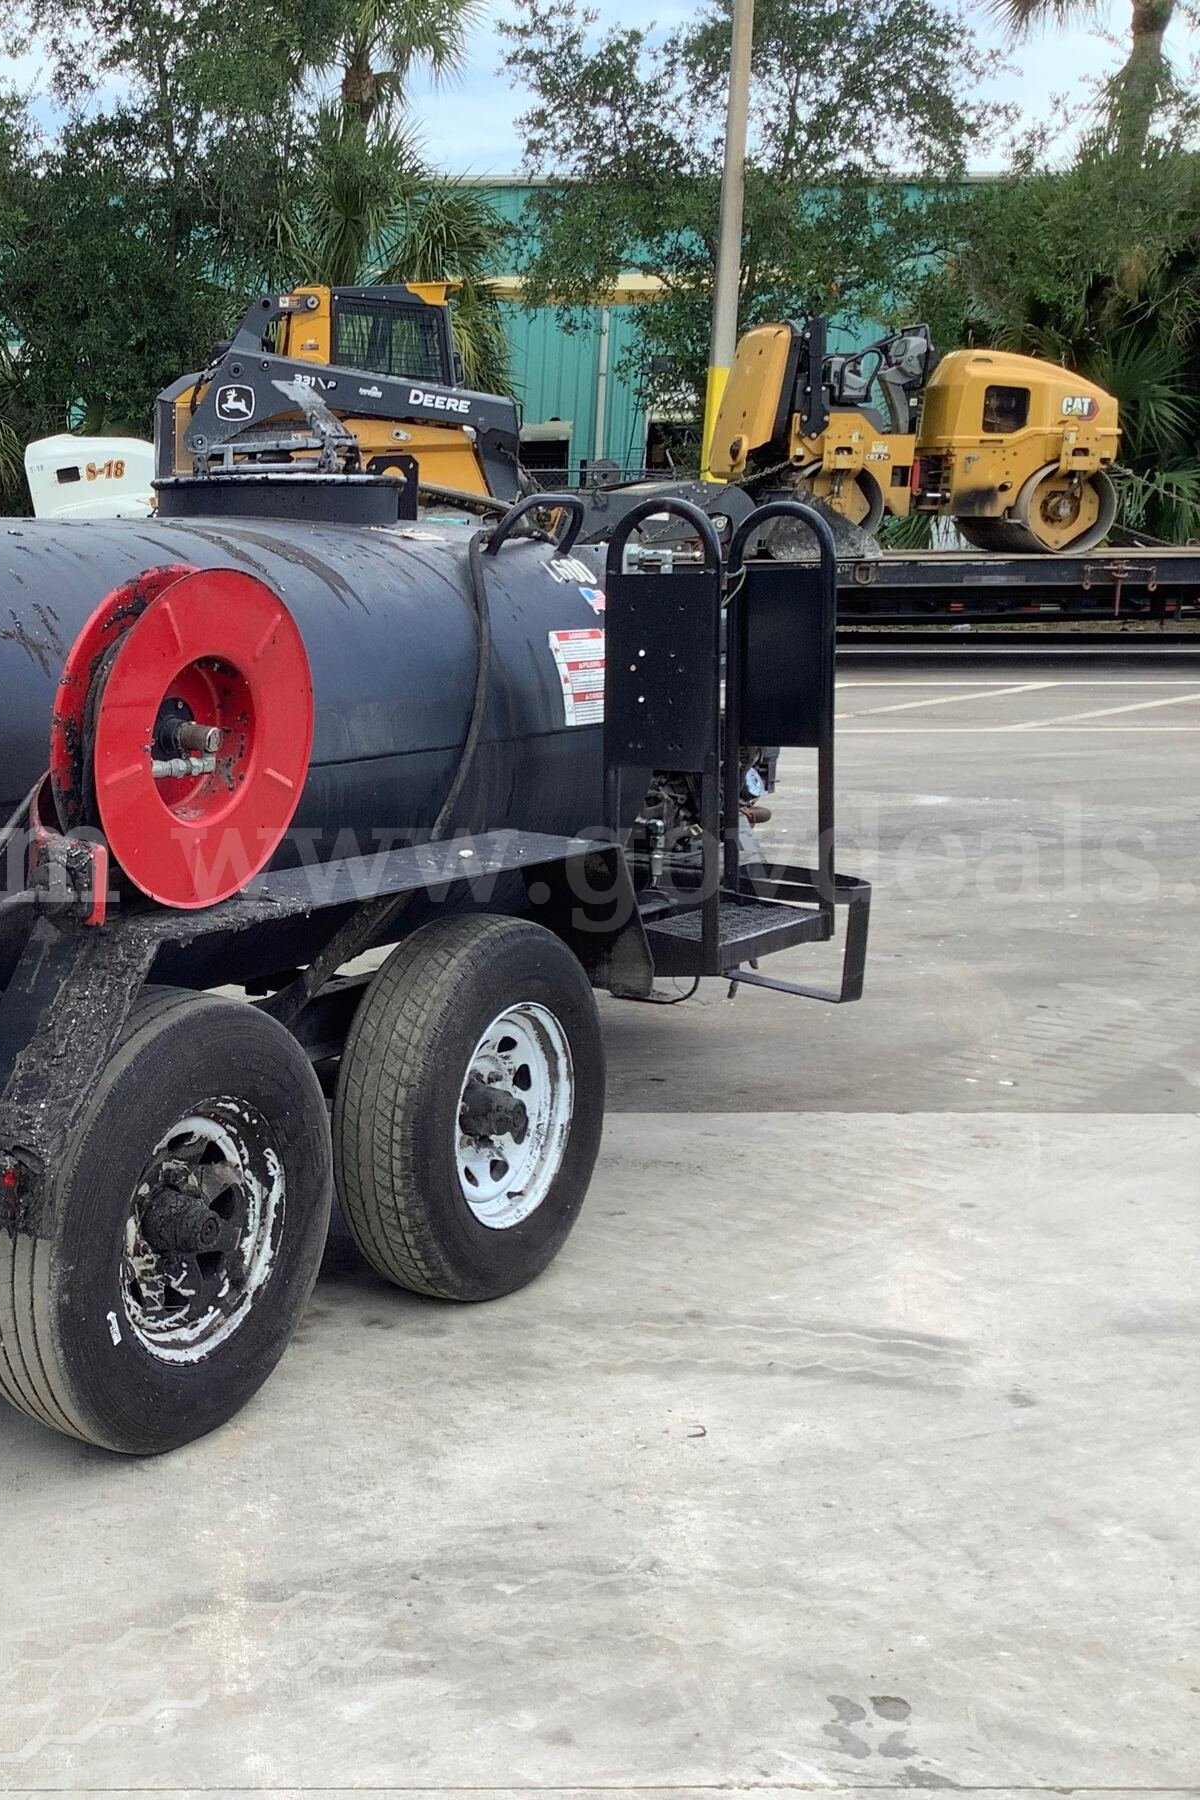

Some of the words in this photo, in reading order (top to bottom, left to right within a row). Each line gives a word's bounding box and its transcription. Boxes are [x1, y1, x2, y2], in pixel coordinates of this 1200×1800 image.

[408, 389, 471, 413] DEERE
[1062, 397, 1092, 416] CAT
[86, 460, 125, 481] S-18
